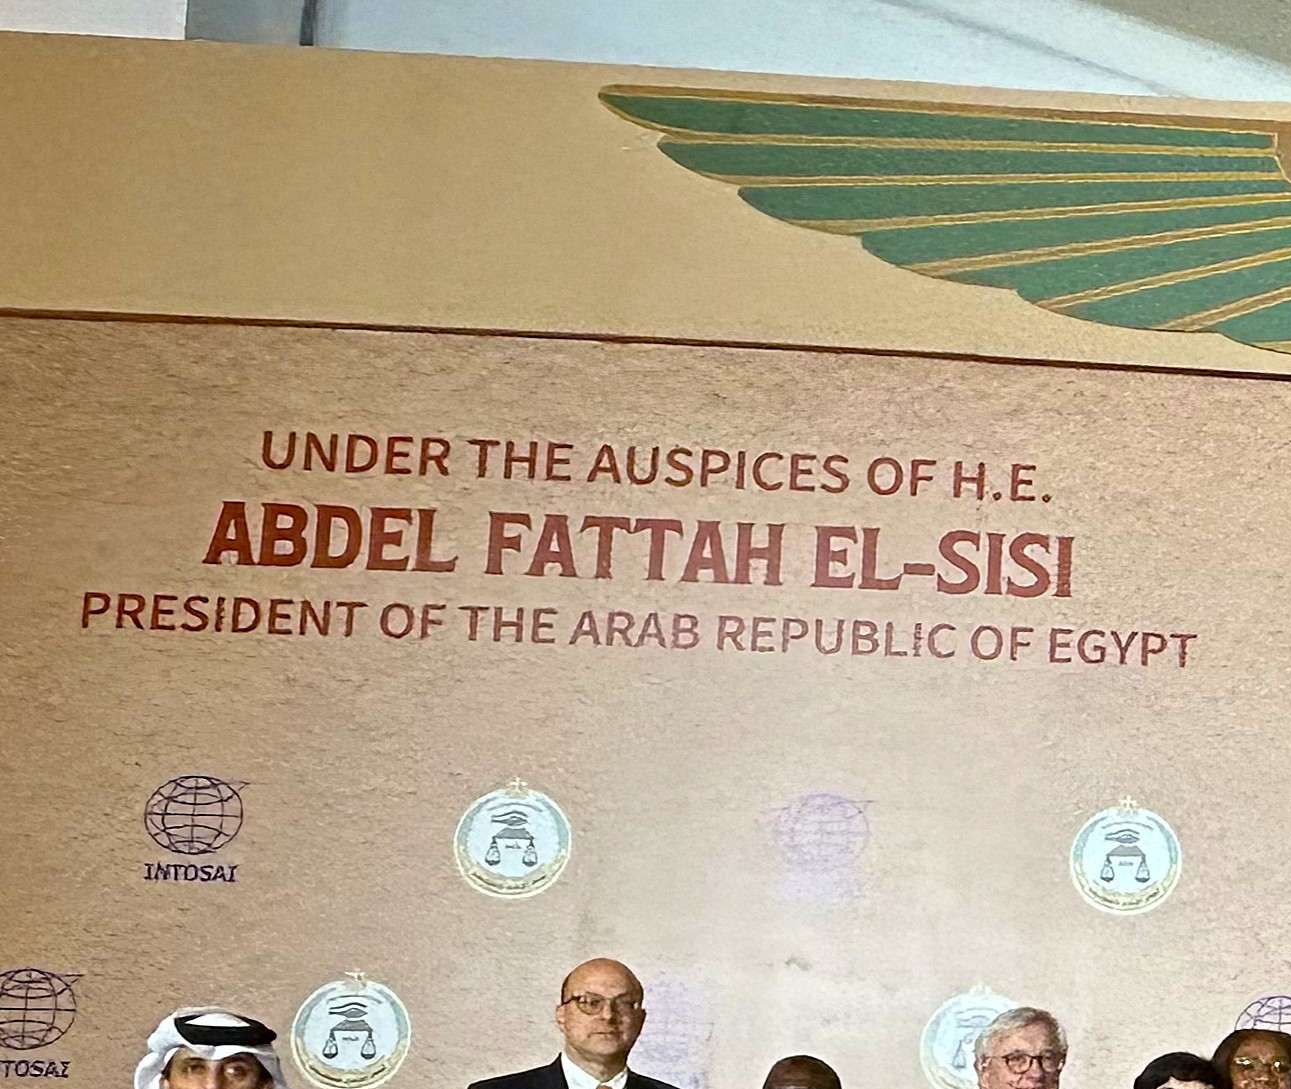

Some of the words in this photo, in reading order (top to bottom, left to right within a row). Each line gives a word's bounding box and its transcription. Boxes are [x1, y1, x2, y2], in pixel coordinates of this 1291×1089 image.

[262, 430, 452, 477] UNDER
[467, 437, 576, 482] THE
[586, 443, 850, 495] AUSPICES
[867, 455, 938, 498] OF
[952, 460, 1054, 504] H.E.
[201, 499, 459, 574] ABDEL
[484, 509, 787, 587] FATTAH
[811, 523, 1076, 599] EL-SISI
[81, 590, 371, 639] PRESIDENT
[379, 602, 448, 640] OF
[457, 604, 560, 645] THE
[568, 609, 701, 652] ARAB
[716, 614, 959, 661] REPUBLIC
[970, 623, 1036, 663] OF
[1047, 626, 1200, 670] EGYPT
[143, 861, 239, 883] INTOSAI
[0, 1059, 71, 1079] TOSAI
